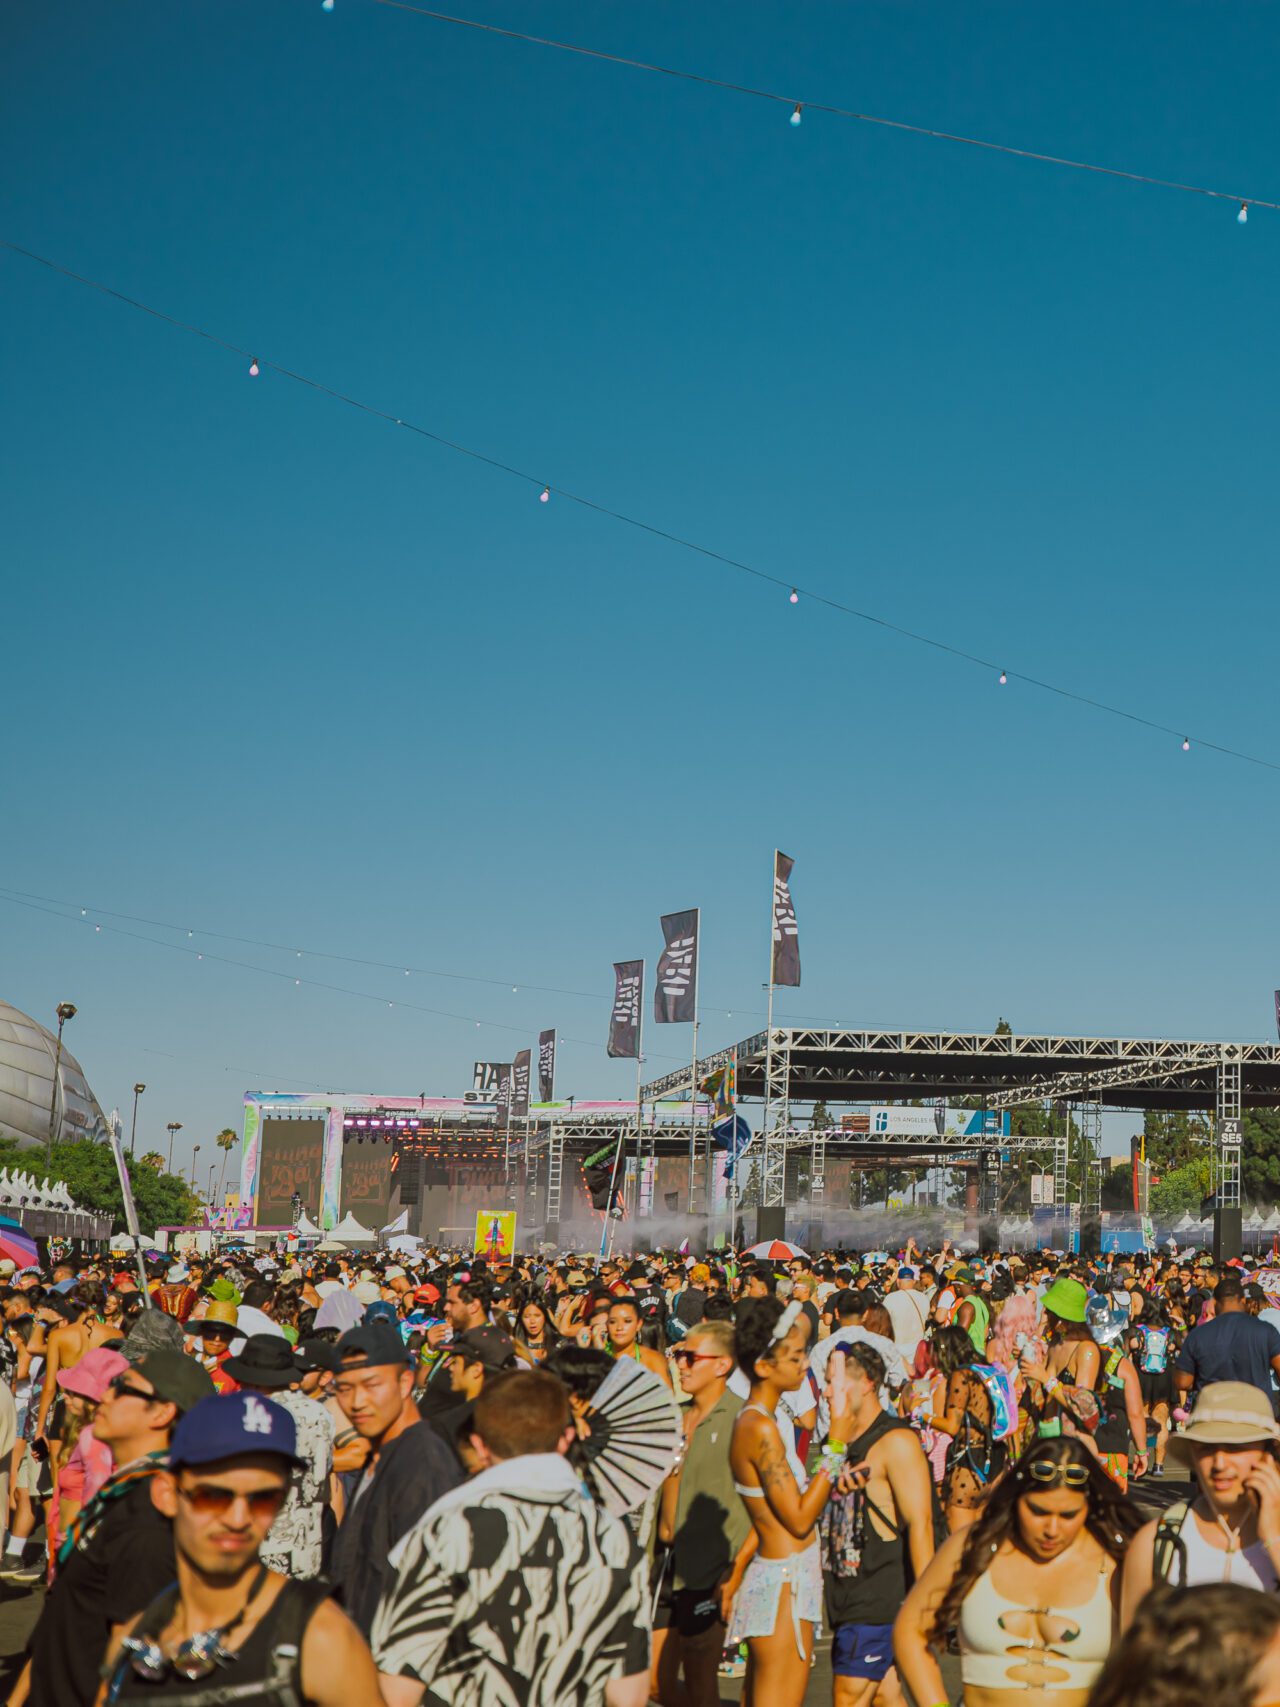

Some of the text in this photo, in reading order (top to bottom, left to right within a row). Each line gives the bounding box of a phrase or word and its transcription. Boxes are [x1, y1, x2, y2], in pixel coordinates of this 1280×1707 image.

[1224, 1121, 1238, 1133] Z1
[1220, 1132, 1243, 1144] SE5
[203, 1206, 252, 1231] VIP
